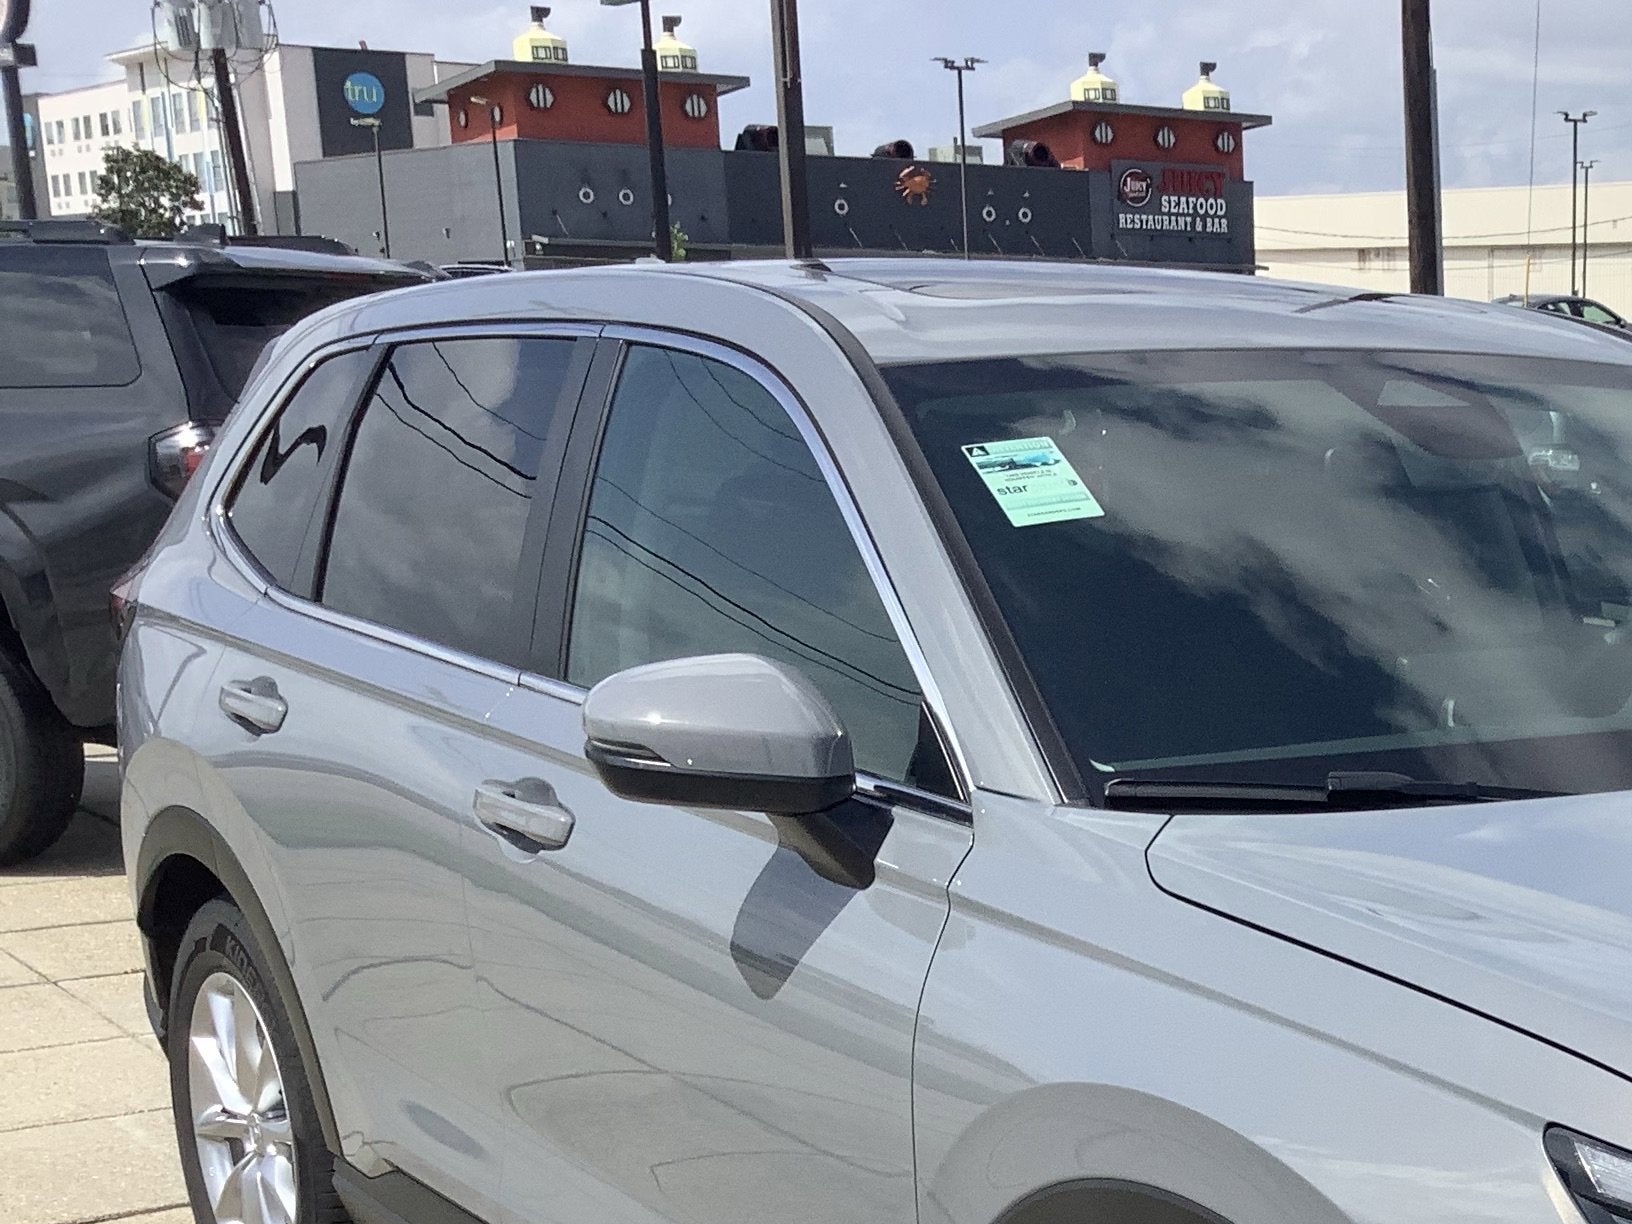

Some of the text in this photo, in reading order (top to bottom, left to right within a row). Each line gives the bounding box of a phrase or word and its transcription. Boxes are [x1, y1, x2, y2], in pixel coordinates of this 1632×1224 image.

[1161, 195, 1227, 215] SEAFOOD
[1119, 213, 1228, 233] RESTAURANT & BAR
[996, 483, 1028, 497] star
